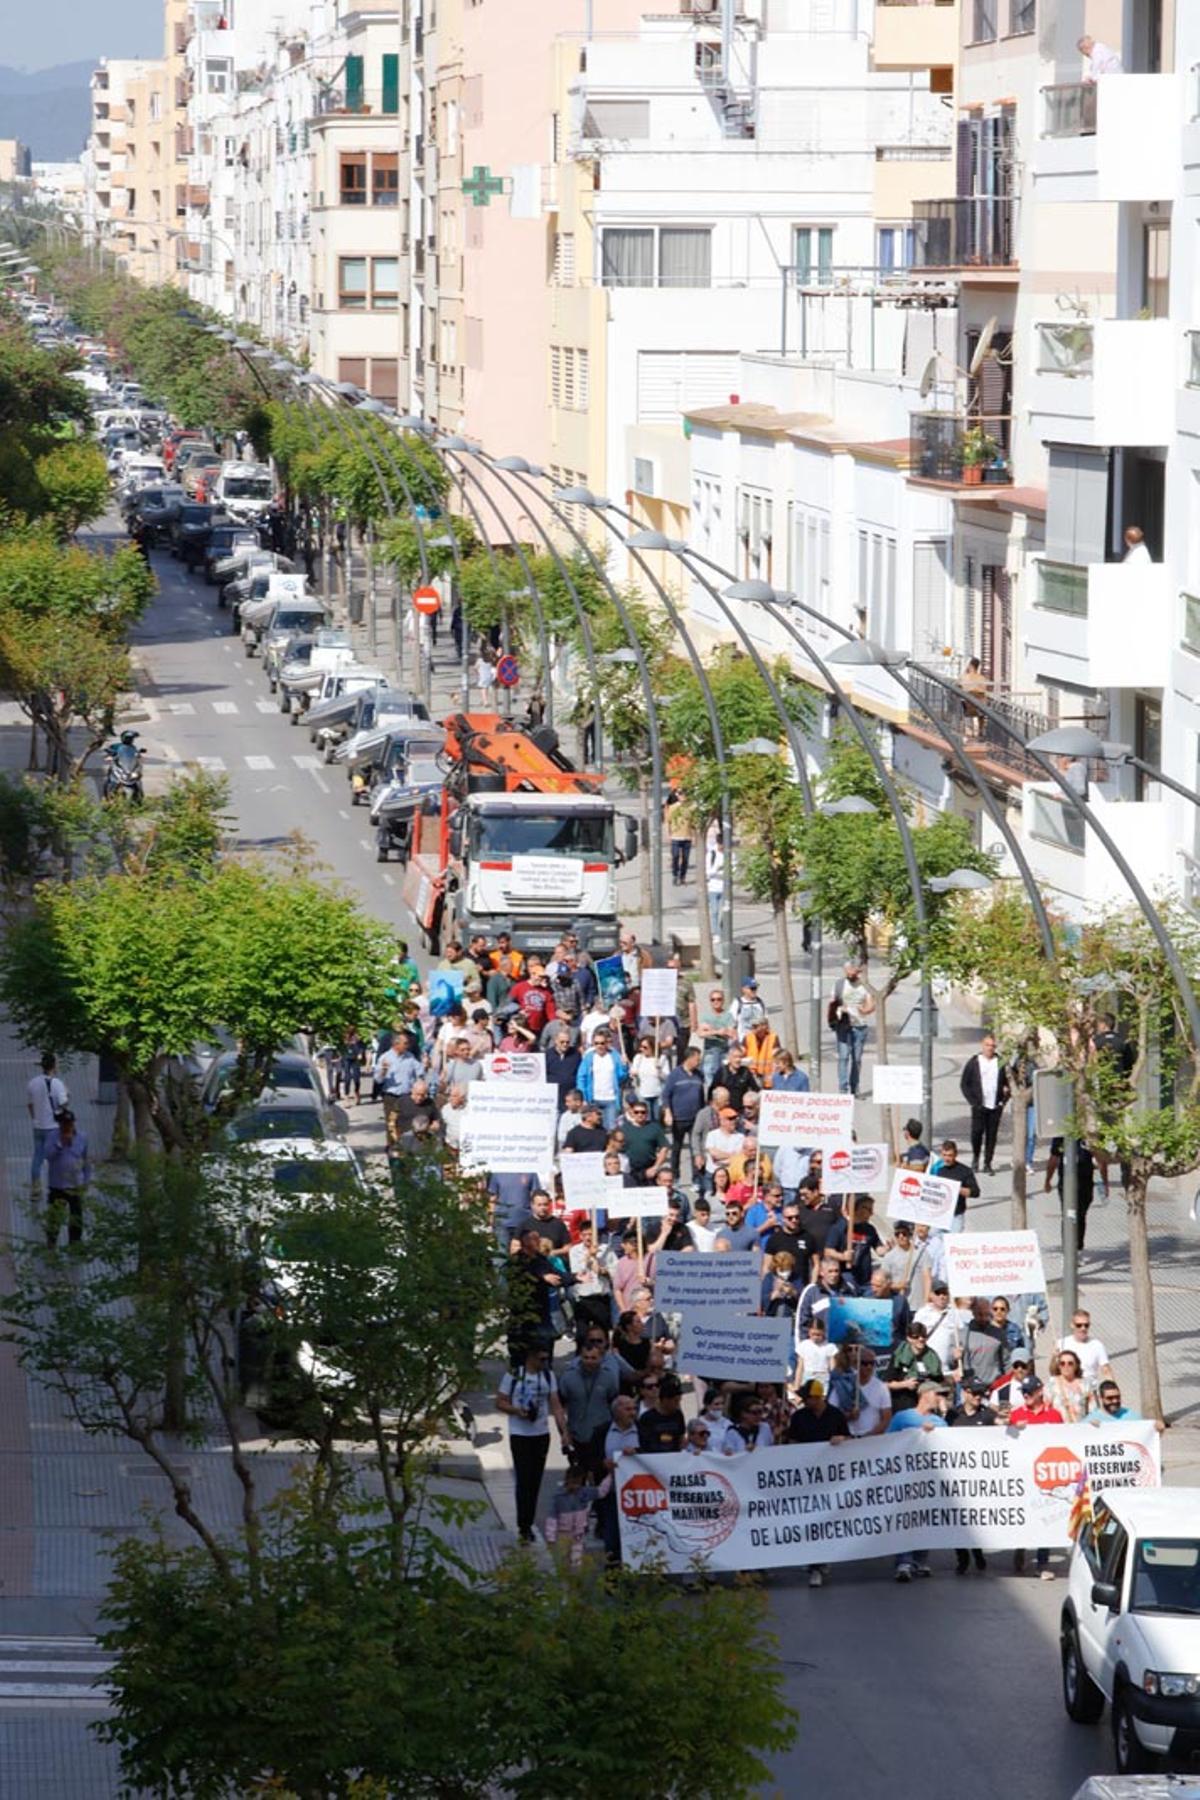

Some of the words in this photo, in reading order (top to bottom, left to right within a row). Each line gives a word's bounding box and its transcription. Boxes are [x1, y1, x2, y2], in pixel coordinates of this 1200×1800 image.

[692, 1325, 745, 1340] Queremos
[747, 1331, 780, 1341] comer
[696, 1340, 707, 1349] el
[707, 1341, 752, 1353] pescado
[753, 1344, 773, 1354] que
[682, 1350, 735, 1364] pescamos
[1084, 1443, 1125, 1457] FALSAS
[757, 1468, 802, 1490] BASTA
[806, 1466, 824, 1485] YA
[828, 1462, 846, 1482] DE
[851, 1456, 902, 1479] FALSAS
[906, 1451, 977, 1472] RESERVAS
[981, 1450, 1010, 1469] QUE
[1036, 1460, 1081, 1482] STOP
[669, 1474, 706, 1488] FALSAS
[623, 1488, 666, 1509] STOP
[670, 1489, 725, 1504] RESERVAS
[747, 1493, 832, 1519] PRIVATIZAN
[836, 1489, 862, 1510] LOS
[866, 1481, 936, 1506] RECURSOS
[940, 1478, 1025, 1499] NATURALES
[671, 1506, 720, 1521] MARINAS
[750, 1526, 770, 1547] DE
[774, 1524, 801, 1545] LOS
[805, 1517, 882, 1542] IBICENCOS
[884, 1515, 894, 1533] Y
[895, 1507, 1026, 1532] FORMENTERENSES
